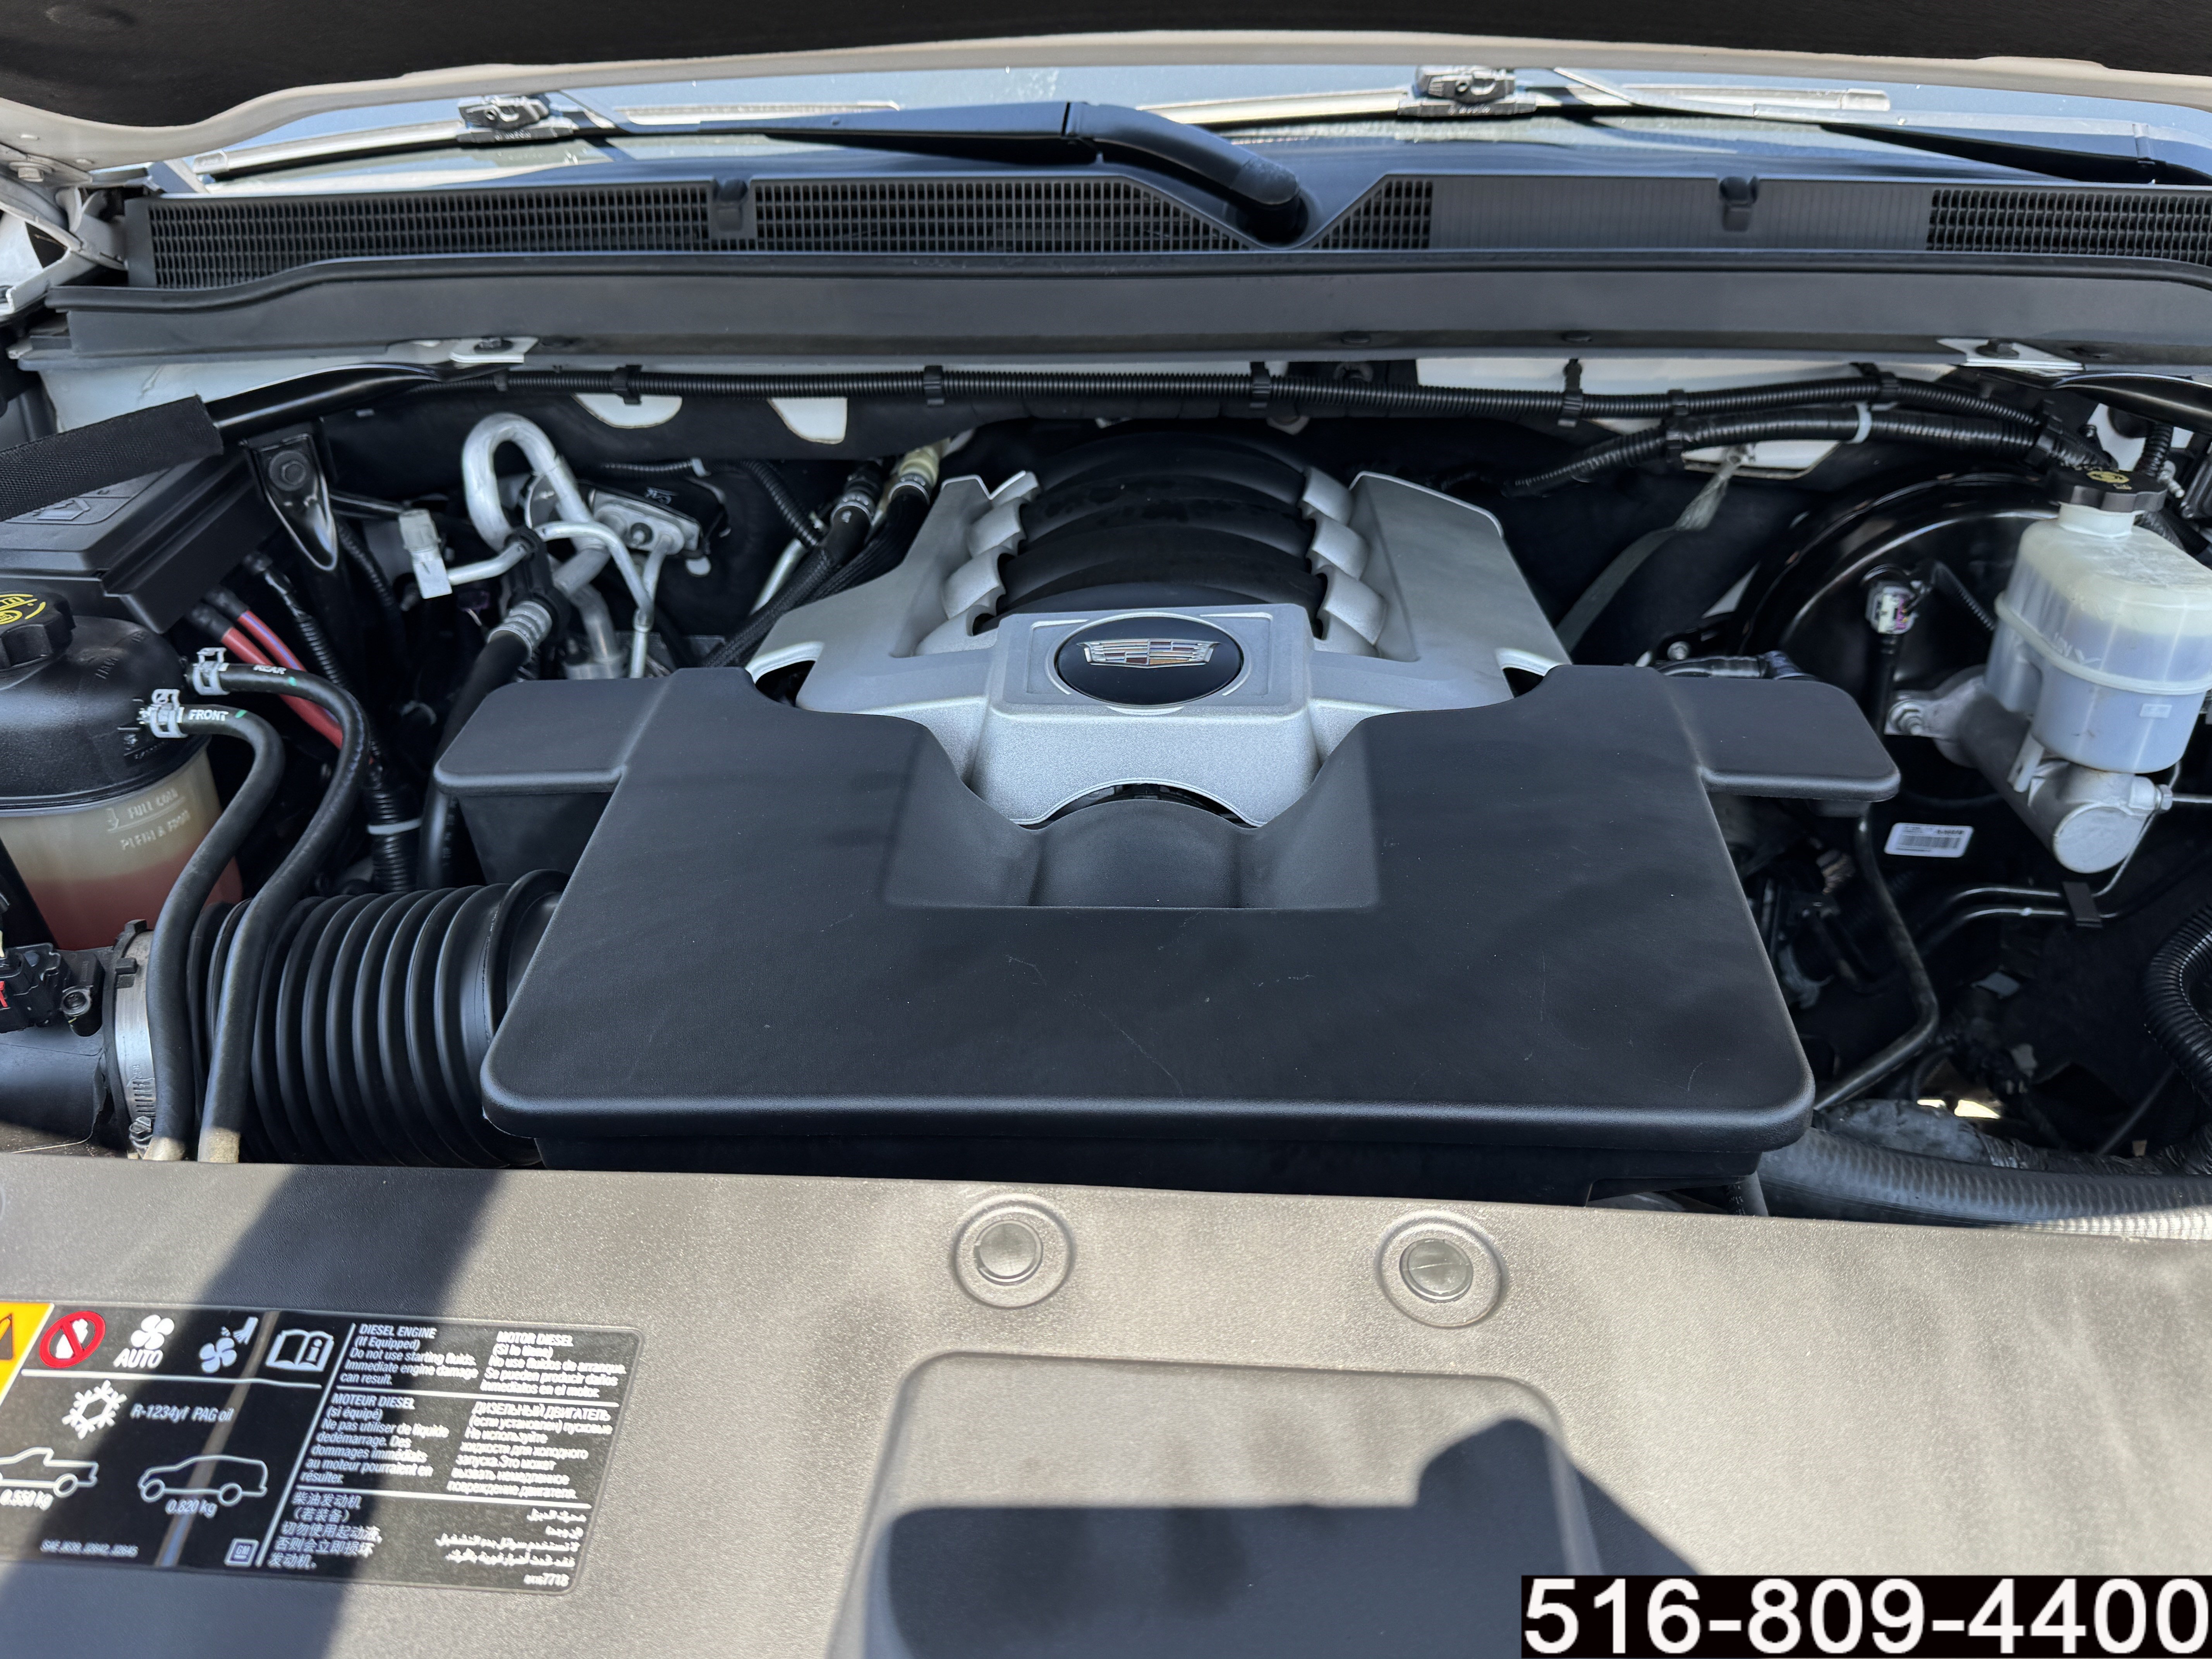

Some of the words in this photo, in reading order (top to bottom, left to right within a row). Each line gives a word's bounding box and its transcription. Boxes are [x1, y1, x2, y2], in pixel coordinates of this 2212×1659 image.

[188, 709, 229, 721] FRONT
[359, 1323, 395, 1336] DIESEL
[397, 1326, 437, 1339] ENGINE
[496, 1331, 536, 1345] MOTOR
[354, 1336, 368, 1348] (If
[368, 1337, 421, 1352] Equipped)
[113, 1348, 163, 1368] AUTO
[349, 1347, 364, 1359] Do
[366, 1350, 384, 1360] not
[385, 1352, 403, 1361] use
[405, 1351, 445, 1366] starting
[488, 1355, 504, 1367] No
[505, 1358, 526, 1368] use
[562, 1359, 577, 1371] de
[344, 1359, 398, 1374] Immediate
[400, 1364, 435, 1377] engine
[436, 1364, 479, 1380] damage
[484, 1367, 500, 1379] Se
[500, 1369, 540, 1381] pueden
[540, 1371, 585, 1384] producir
[340, 1373, 359, 1383] can
[361, 1373, 393, 1385] result.
[539, 1385, 554, 1395] en
[554, 1384, 567, 1395] el
[331, 1393, 377, 1407] MOTEUR
[377, 1396, 415, 1410] DIESEL
[130, 1403, 190, 1424] R-1234yf
[192, 1406, 218, 1422] PAG
[218, 1407, 234, 1422] oil
[326, 1406, 342, 1418] (si
[343, 1407, 383, 1421] équipé)
[472, 1401, 545, 1417] ДИЗЕЛЬНЫЙ
[544, 1405, 611, 1422] ДВИГАТЕЛЬ
[321, 1418, 337, 1430] Ne
[338, 1420, 358, 1432] pas
[359, 1420, 397, 1434] utiliser
[397, 1422, 412, 1436] de
[412, 1423, 449, 1439] liquide
[465, 1426, 481, 1440] Не
[316, 1431, 387, 1448] dedémarrage.
[389, 1434, 412, 1448] Des
[311, 1444, 371, 1460] dommages
[371, 1448, 428, 1463] immédiats
[305, 1459, 321, 1469] au
[321, 1460, 361, 1472] moteur
[361, 1462, 418, 1476] pourraient
[417, 1465, 434, 1477] en
[300, 1470, 344, 1485] résulter.
[165, 1499, 199, 1515] 0.820
[199, 1499, 218, 1519] kg
[291, 1491, 362, 1510] 柴油发动机
[236, 1545, 251, 1555] GM
[267, 1552, 317, 1570] 发动机。
